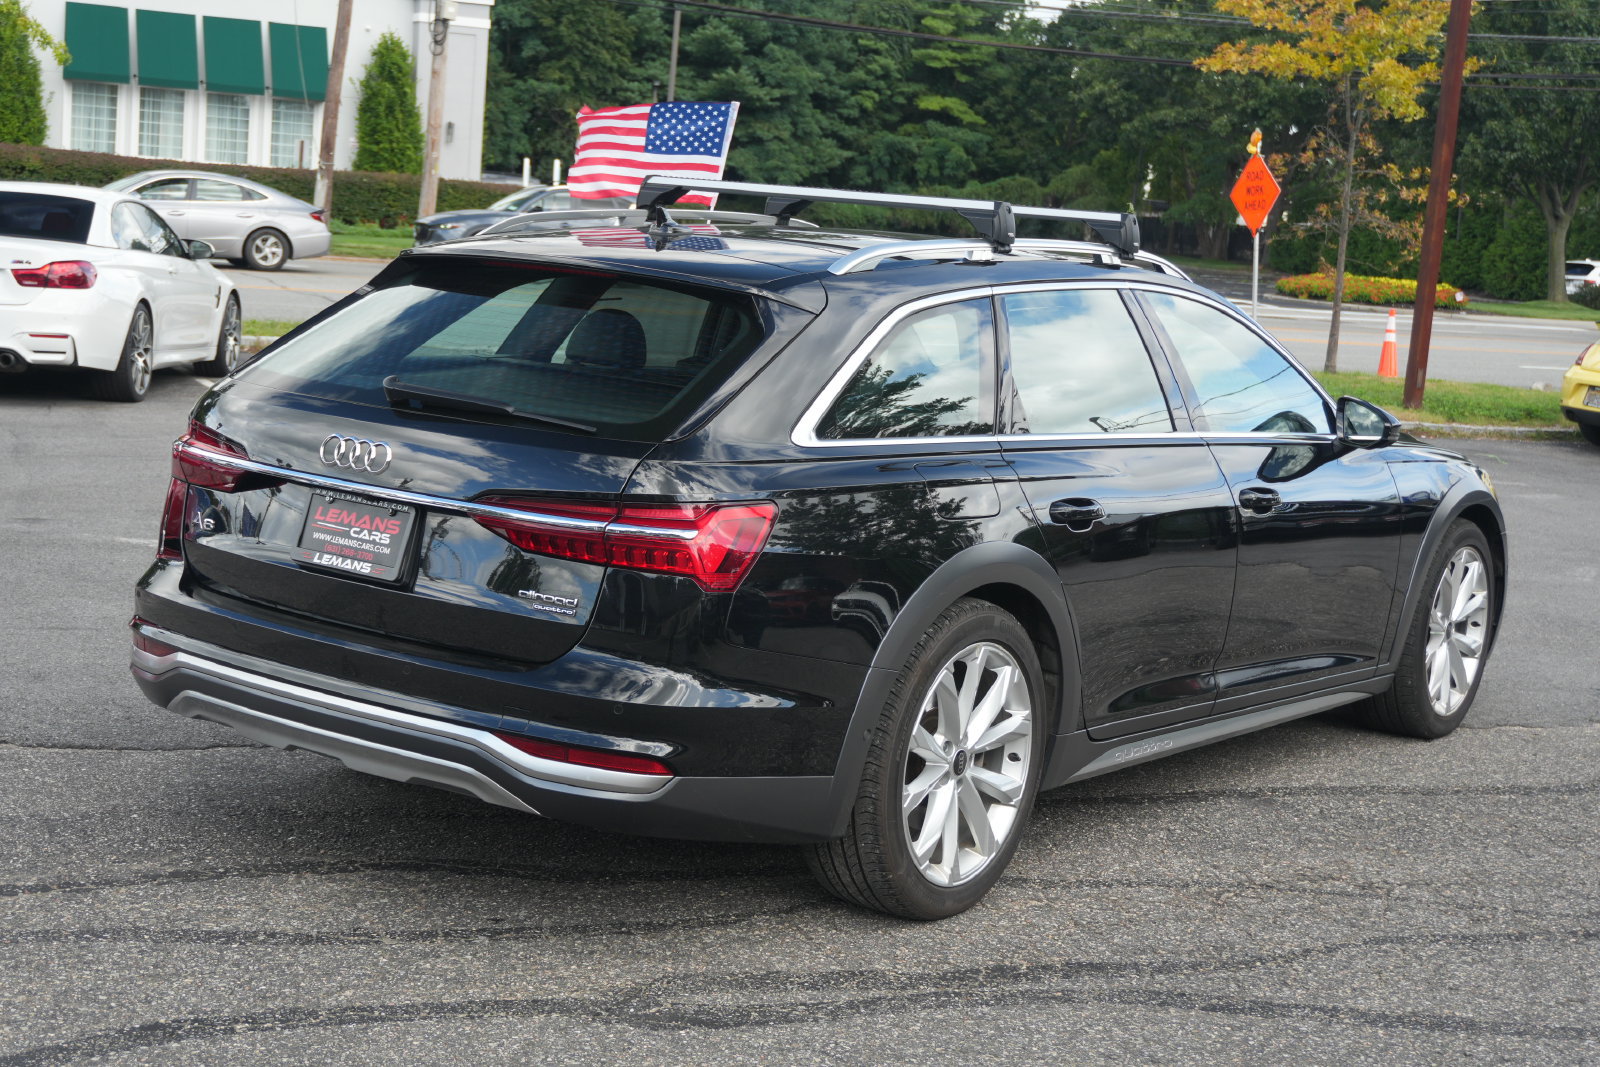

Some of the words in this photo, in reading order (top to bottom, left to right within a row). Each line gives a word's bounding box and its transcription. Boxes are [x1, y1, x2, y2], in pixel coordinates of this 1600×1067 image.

[1246, 170, 1264, 180] ROAD
[1246, 185, 1263, 195] WORK
[1245, 200, 1266, 210] AHEAD
[193, 511, 215, 530] A6
[314, 506, 401, 534] LEMANS
[313, 531, 391, 554] WWW.LEMANSCARS.COM
[349, 527, 391, 544] CARS
[313, 552, 373, 573] LEMANS
[518, 590, 578, 608] allroad
[533, 603, 574, 615] quattro
[1115, 740, 1173, 762] quattro
